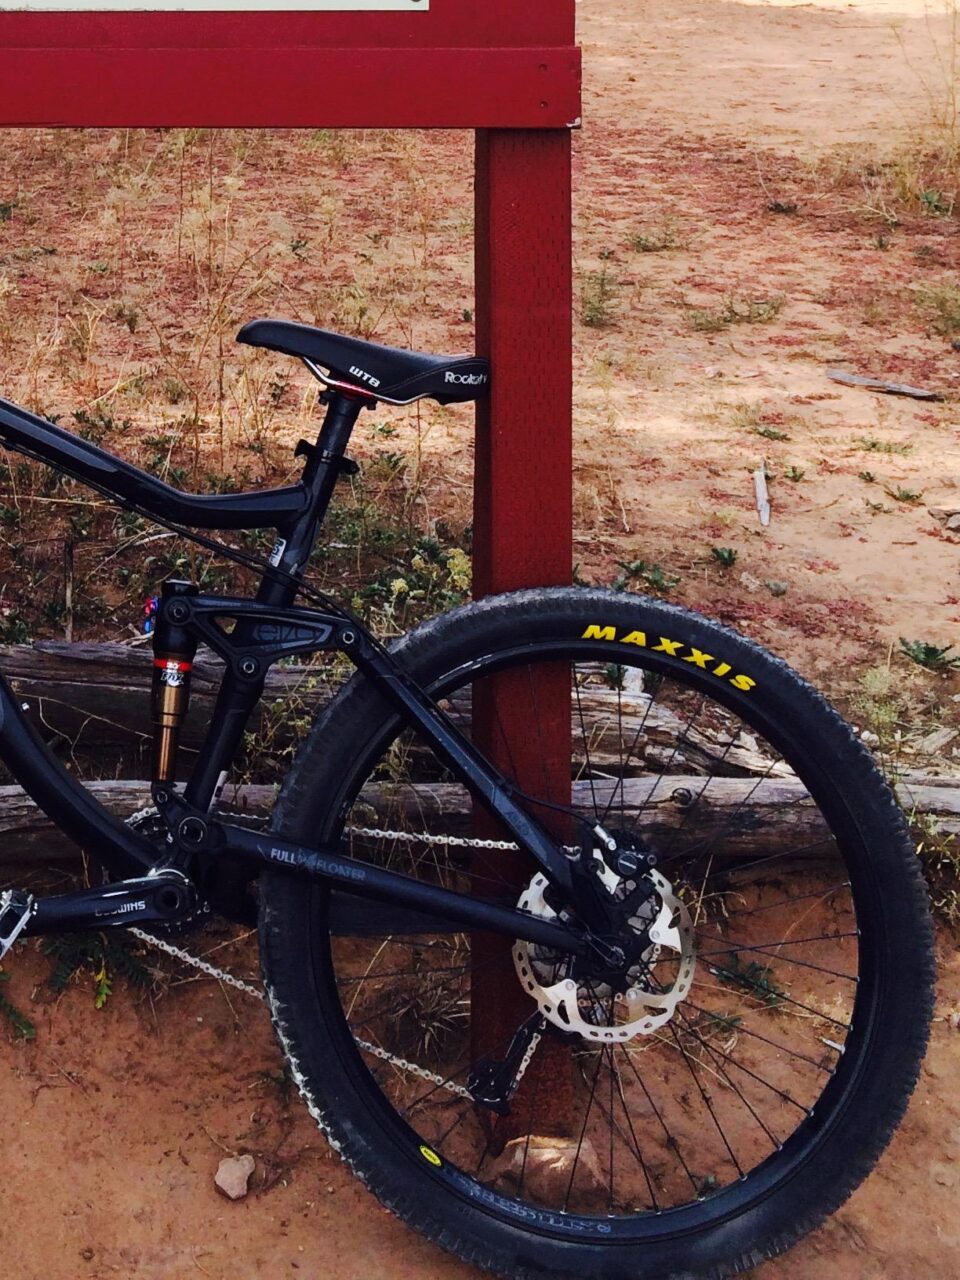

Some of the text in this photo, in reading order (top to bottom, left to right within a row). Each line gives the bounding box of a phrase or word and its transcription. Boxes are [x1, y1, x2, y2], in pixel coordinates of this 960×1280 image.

[348, 365, 381, 388] WTB
[581, 624, 757, 691] MAXXIS
[260, 847, 298, 865] FULL
